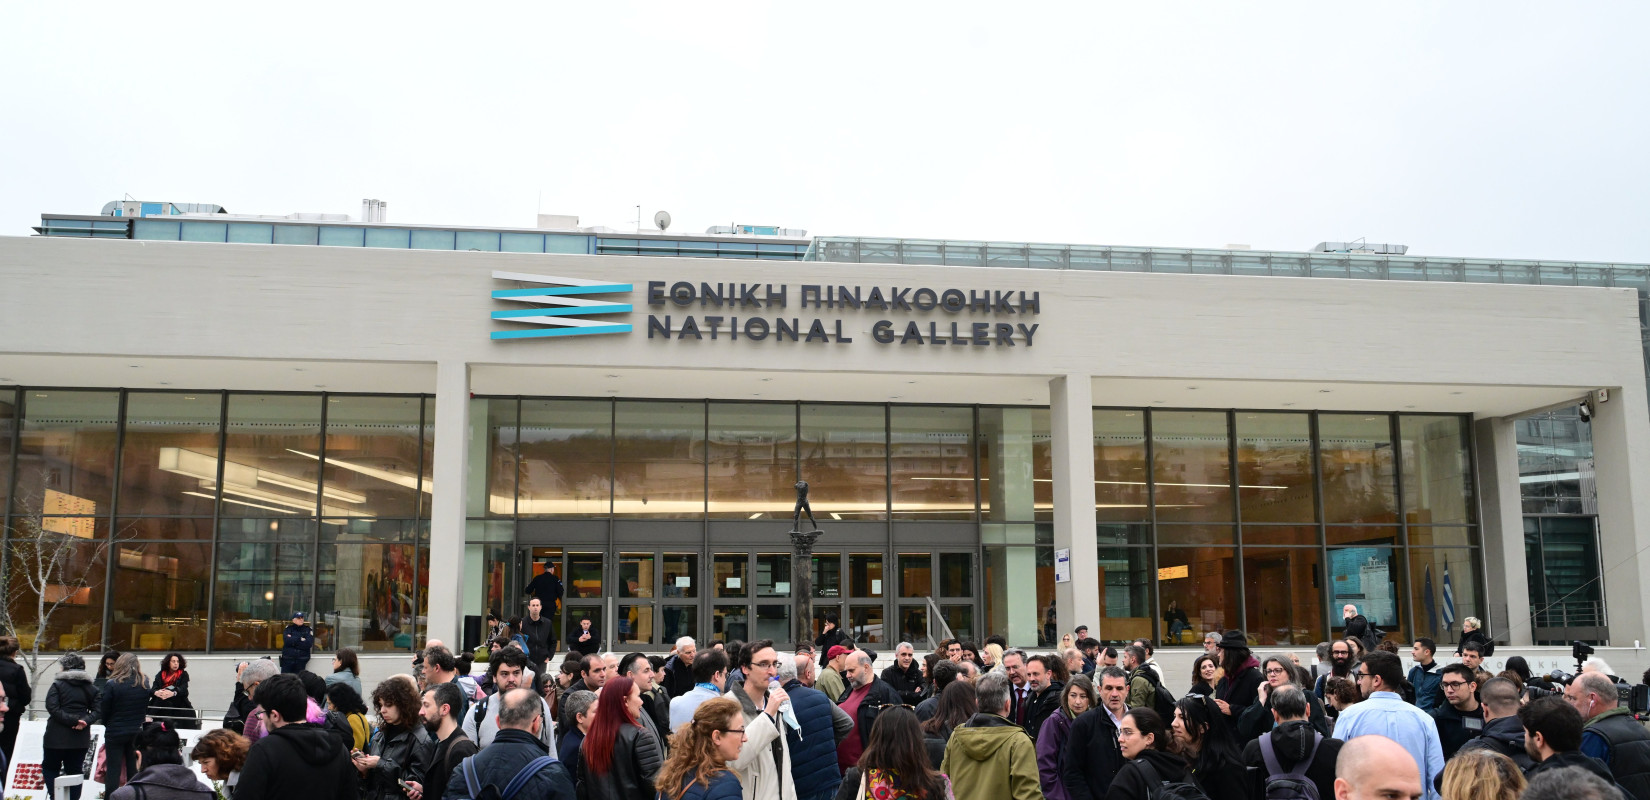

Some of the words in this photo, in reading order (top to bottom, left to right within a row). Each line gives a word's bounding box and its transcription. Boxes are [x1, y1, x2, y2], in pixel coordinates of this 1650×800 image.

[648, 281, 787, 308] ΕΘΝΙΚΗ
[801, 285, 1040, 314] ΠΙΝΑΚΟΘΗΚΗ
[648, 315, 852, 343] NATIONAL
[873, 320, 1039, 346] GALLERY
